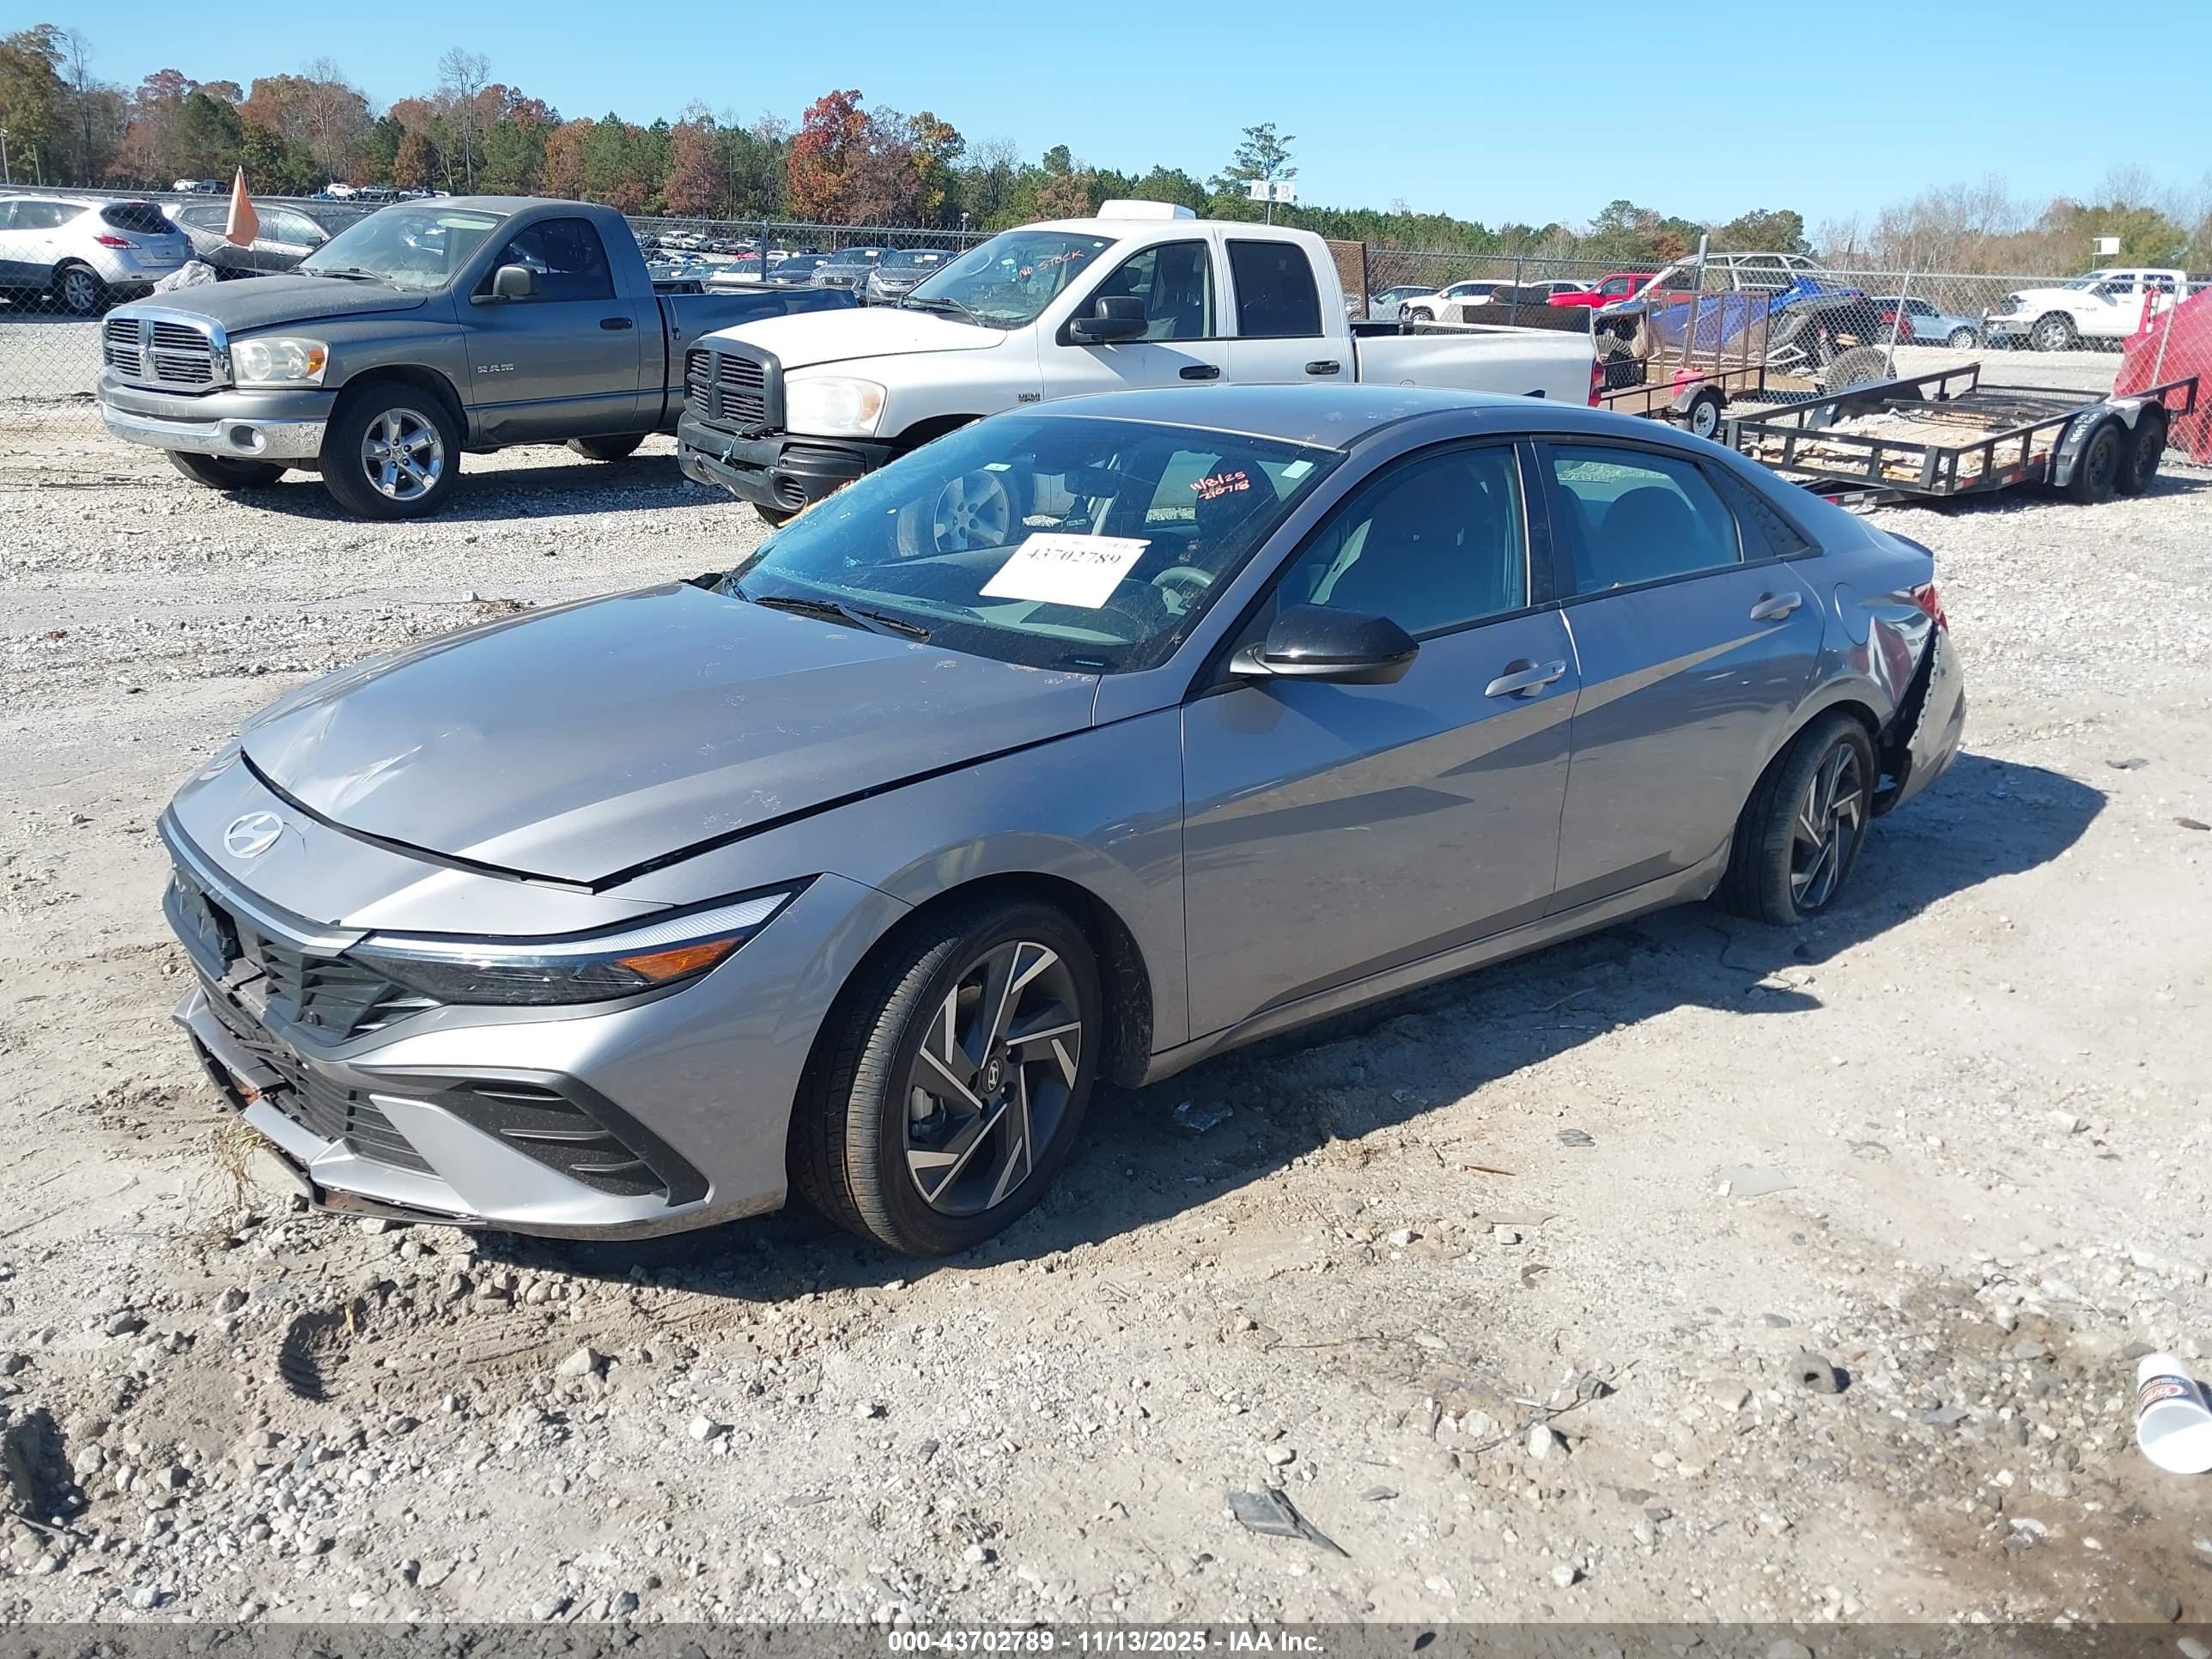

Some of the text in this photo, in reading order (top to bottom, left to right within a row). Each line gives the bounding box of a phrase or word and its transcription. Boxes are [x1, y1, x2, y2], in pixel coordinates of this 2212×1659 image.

[1037, 249, 1085, 270] STOCK
[477, 362, 515, 374] RAM
[1026, 547, 1122, 564] 43702789
